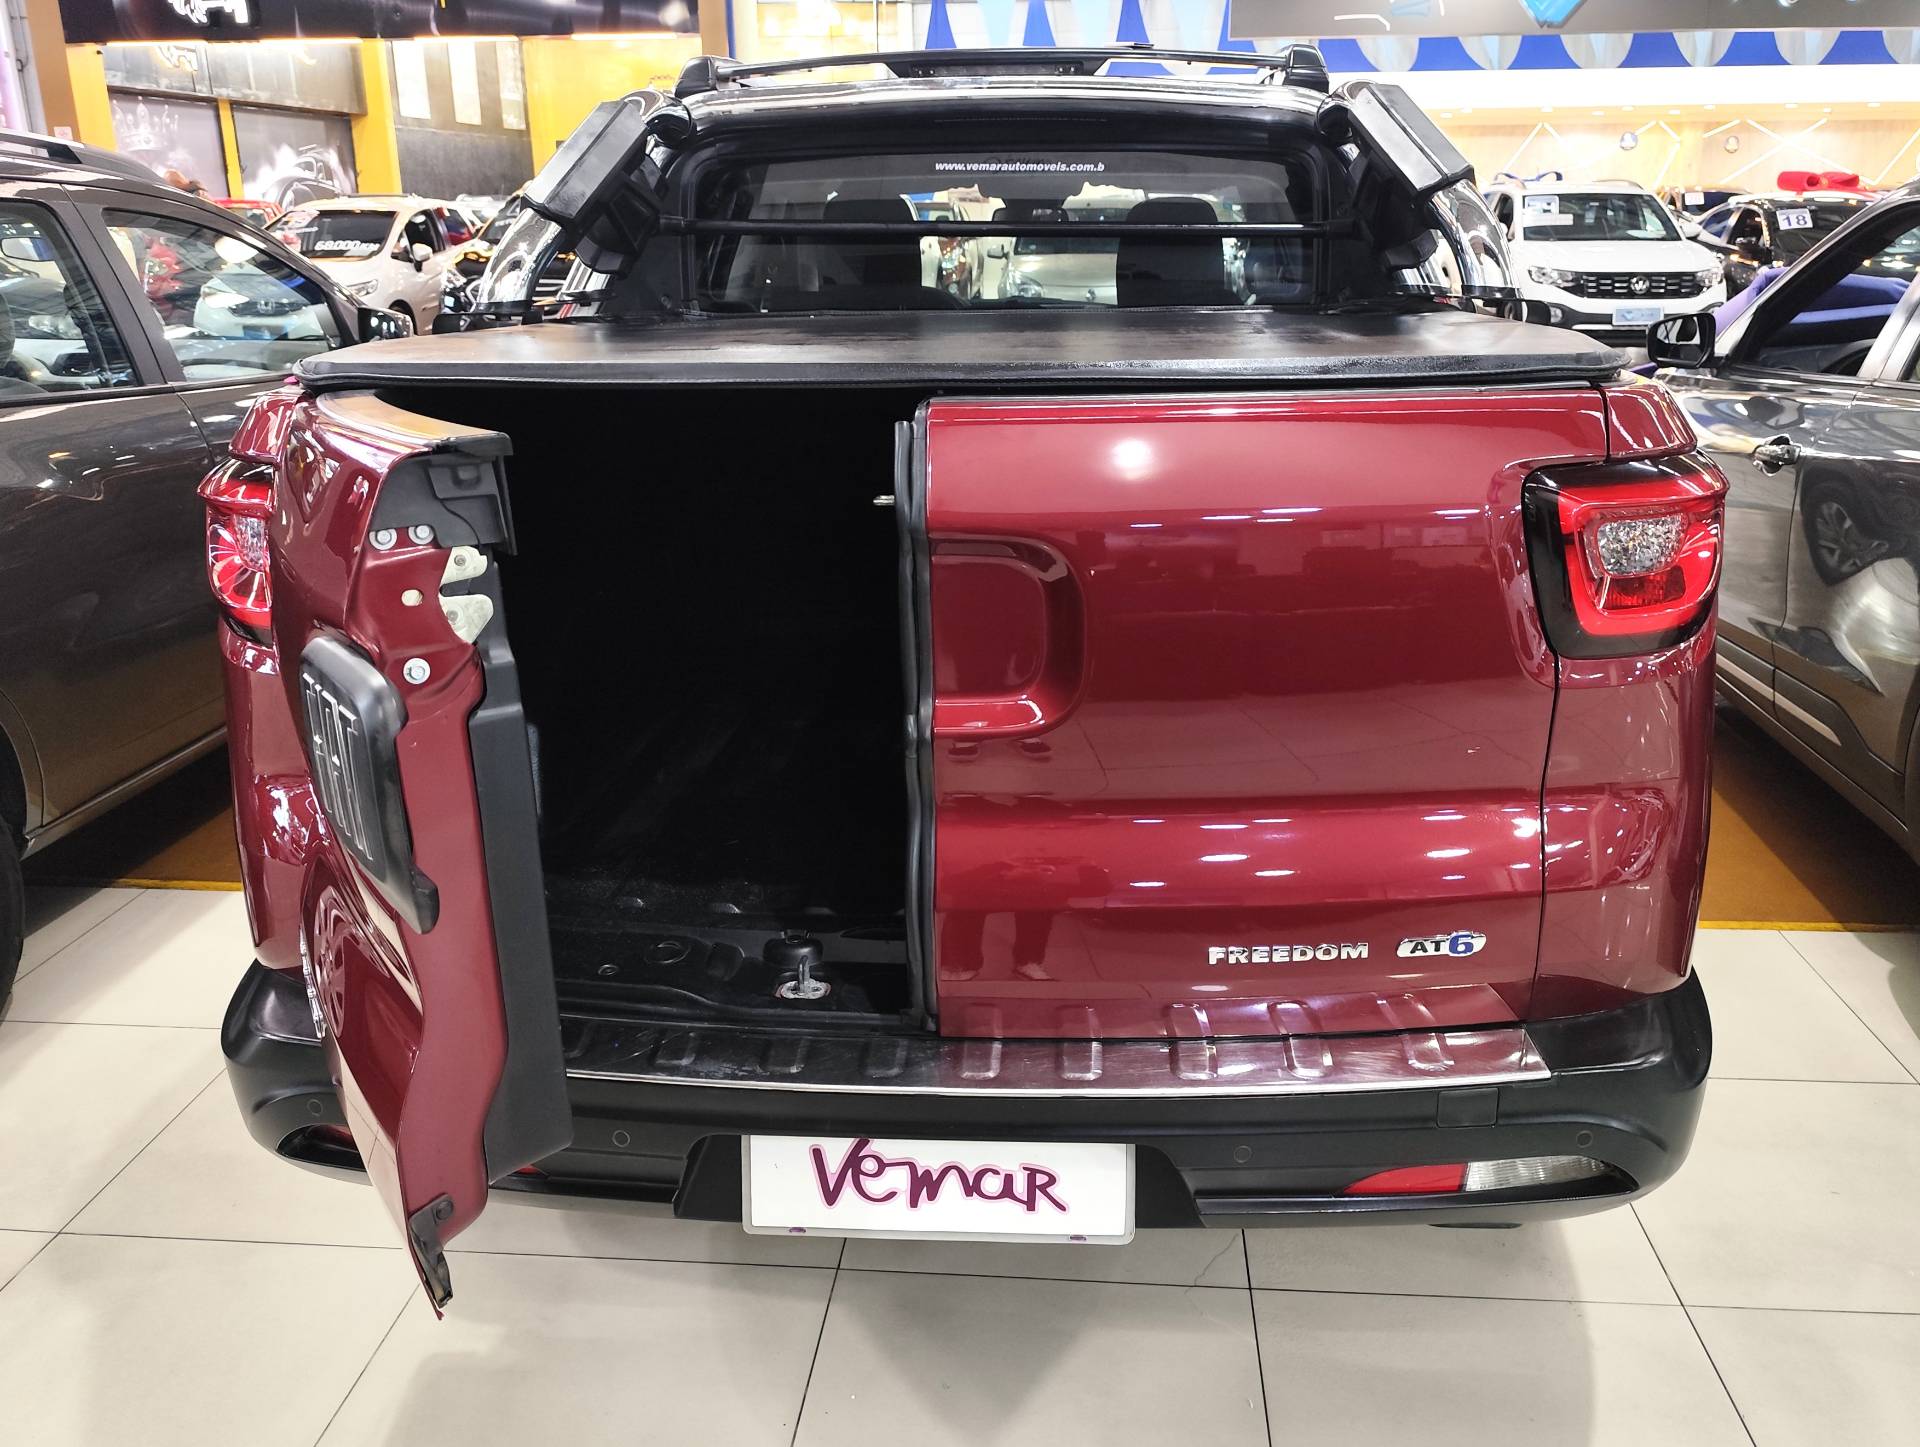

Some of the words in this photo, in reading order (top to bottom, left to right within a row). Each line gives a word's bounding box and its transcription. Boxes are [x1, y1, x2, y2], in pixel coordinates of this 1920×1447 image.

[1782, 214, 1808, 227] 18
[1207, 942, 1369, 965] FREEDOM
[1408, 933, 1475, 955] AT6
